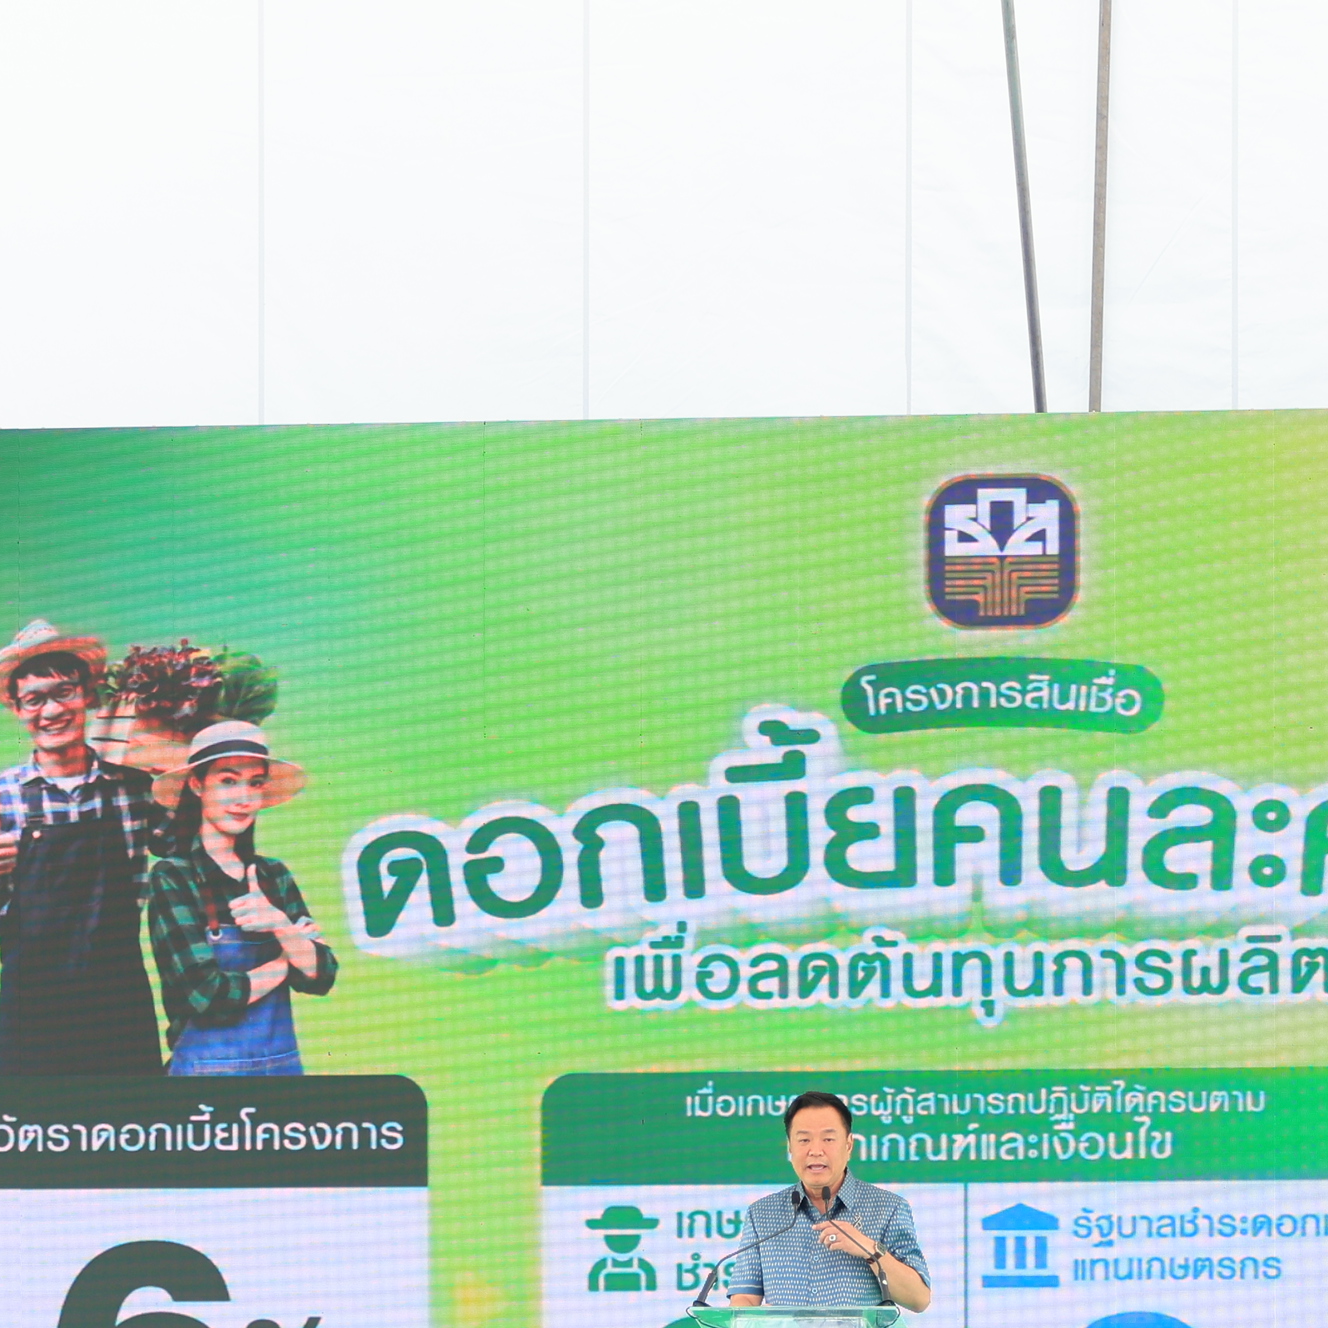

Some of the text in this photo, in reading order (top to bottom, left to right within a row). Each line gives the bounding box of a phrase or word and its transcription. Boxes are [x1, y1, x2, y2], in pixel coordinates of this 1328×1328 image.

[859, 668, 1143, 717] โครงการสินเชื่อ
[1073, 1255, 1283, 1281] แทนเกษตรกร
